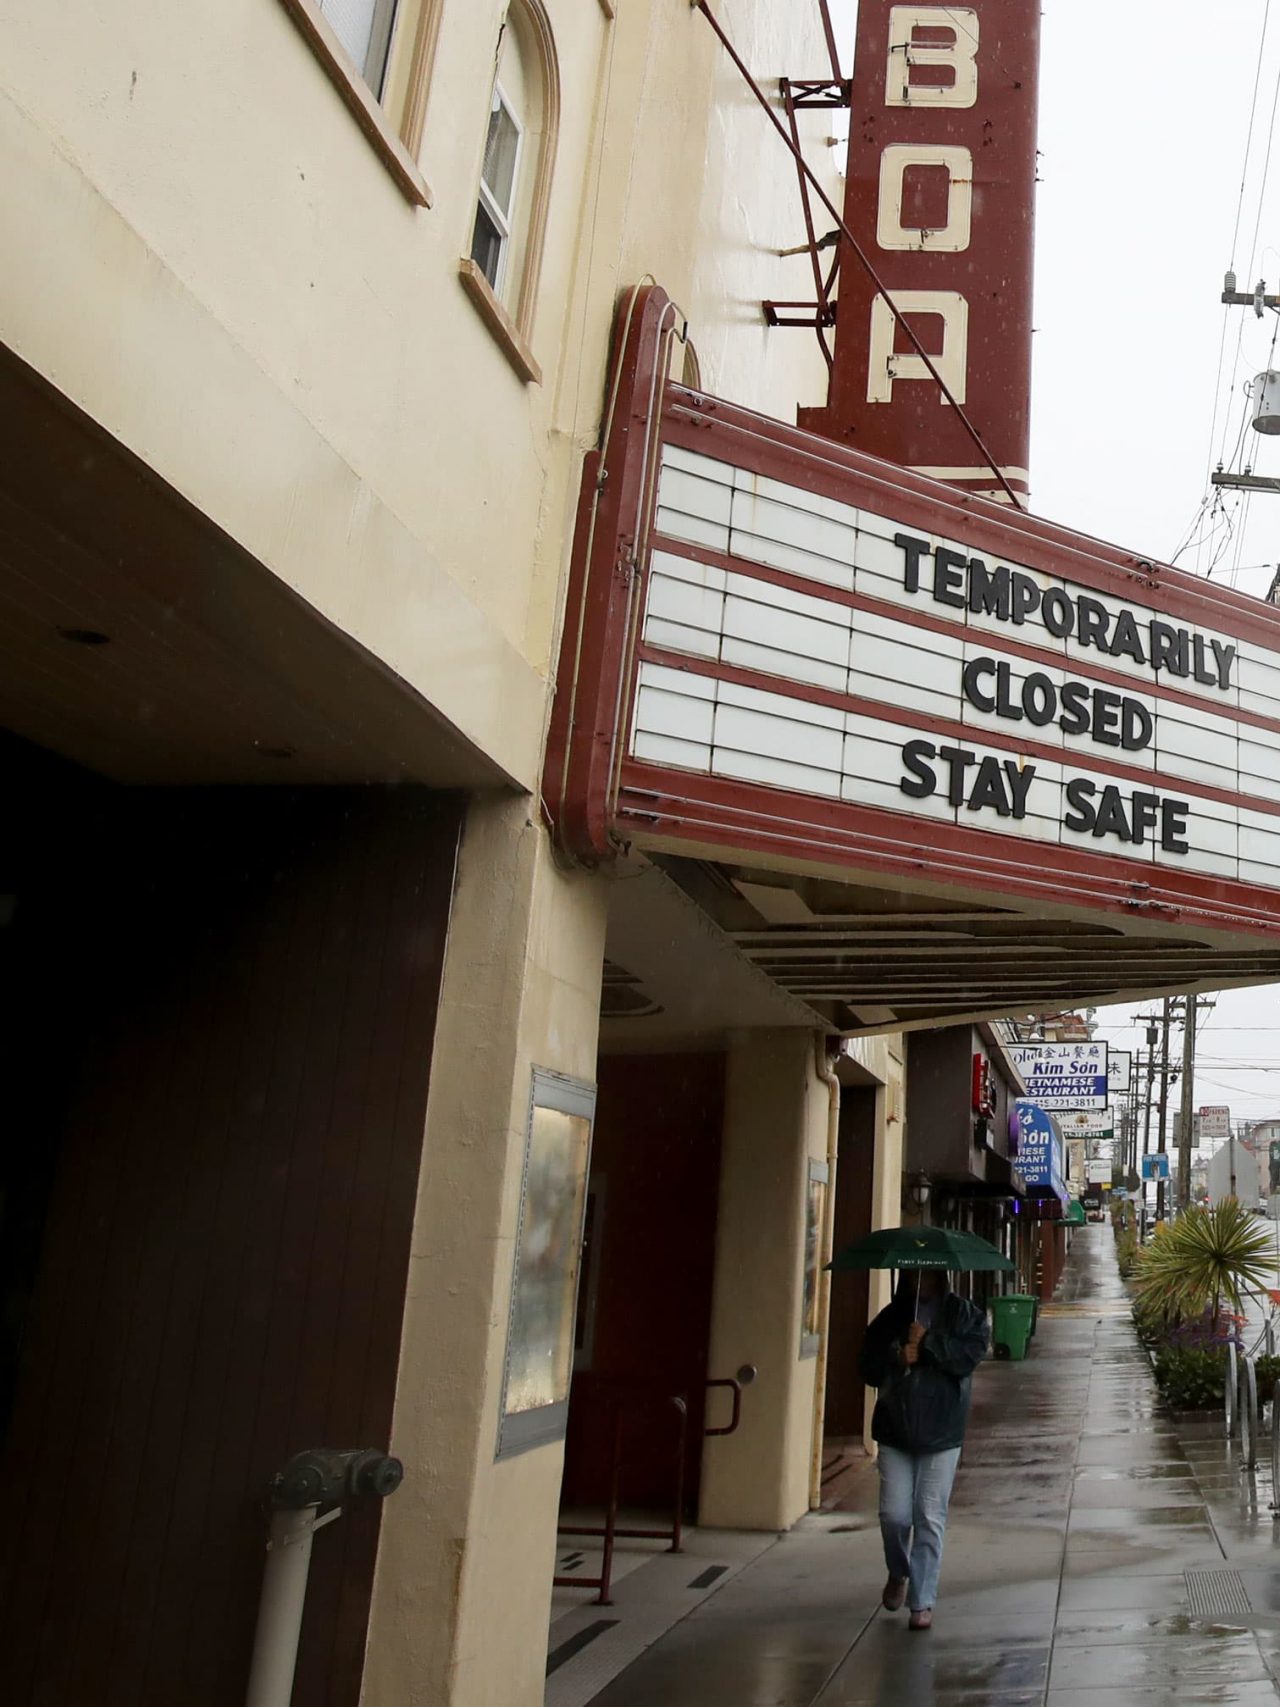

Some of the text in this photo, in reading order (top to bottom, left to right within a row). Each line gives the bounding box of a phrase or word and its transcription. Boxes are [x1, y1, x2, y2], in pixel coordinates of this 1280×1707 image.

[895, 533, 1236, 690] TEMPORARILY
[964, 657, 1153, 751] CLOSED
[900, 740, 1190, 854] STAY SAFE
[1033, 1062, 1064, 1075] Kim
[1024, 1077, 1095, 1087] IETNAMESE
[1025, 1086, 1097, 1096] ESTAURANT
[1025, 1174, 1039, 1182] GO
